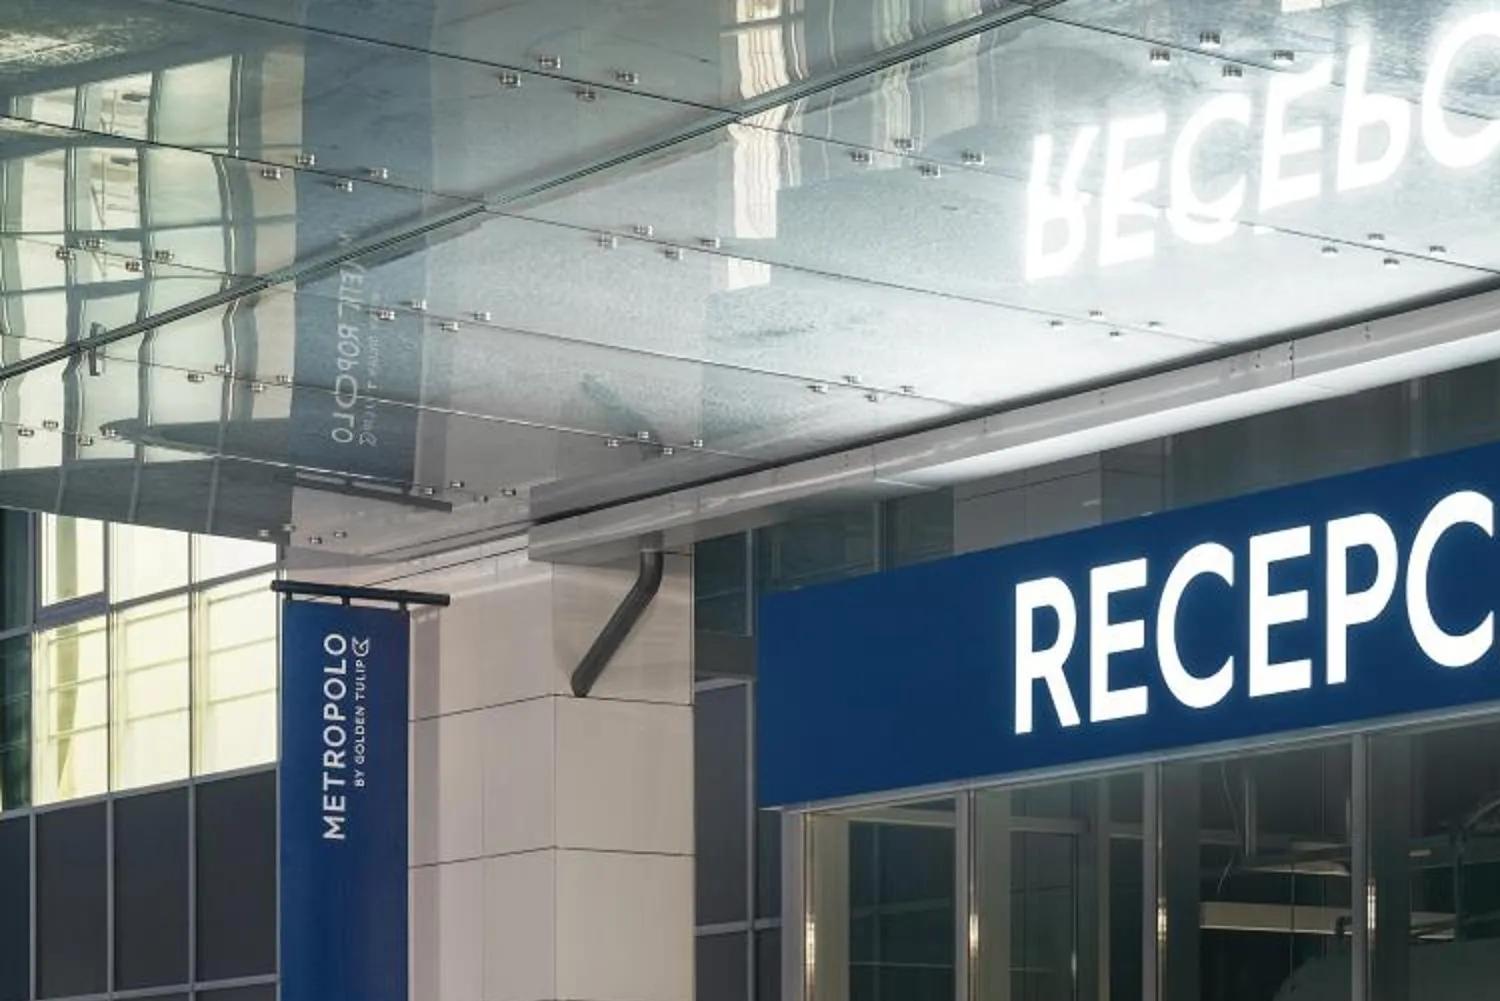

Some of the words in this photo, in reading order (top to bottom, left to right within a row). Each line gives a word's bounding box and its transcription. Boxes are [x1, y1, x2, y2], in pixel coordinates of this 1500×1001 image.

[355, 659, 365, 700] TULIP
[323, 633, 347, 840] METROPOLO
[355, 706, 365, 765] GOLDEN
[354, 769, 365, 787] BY
